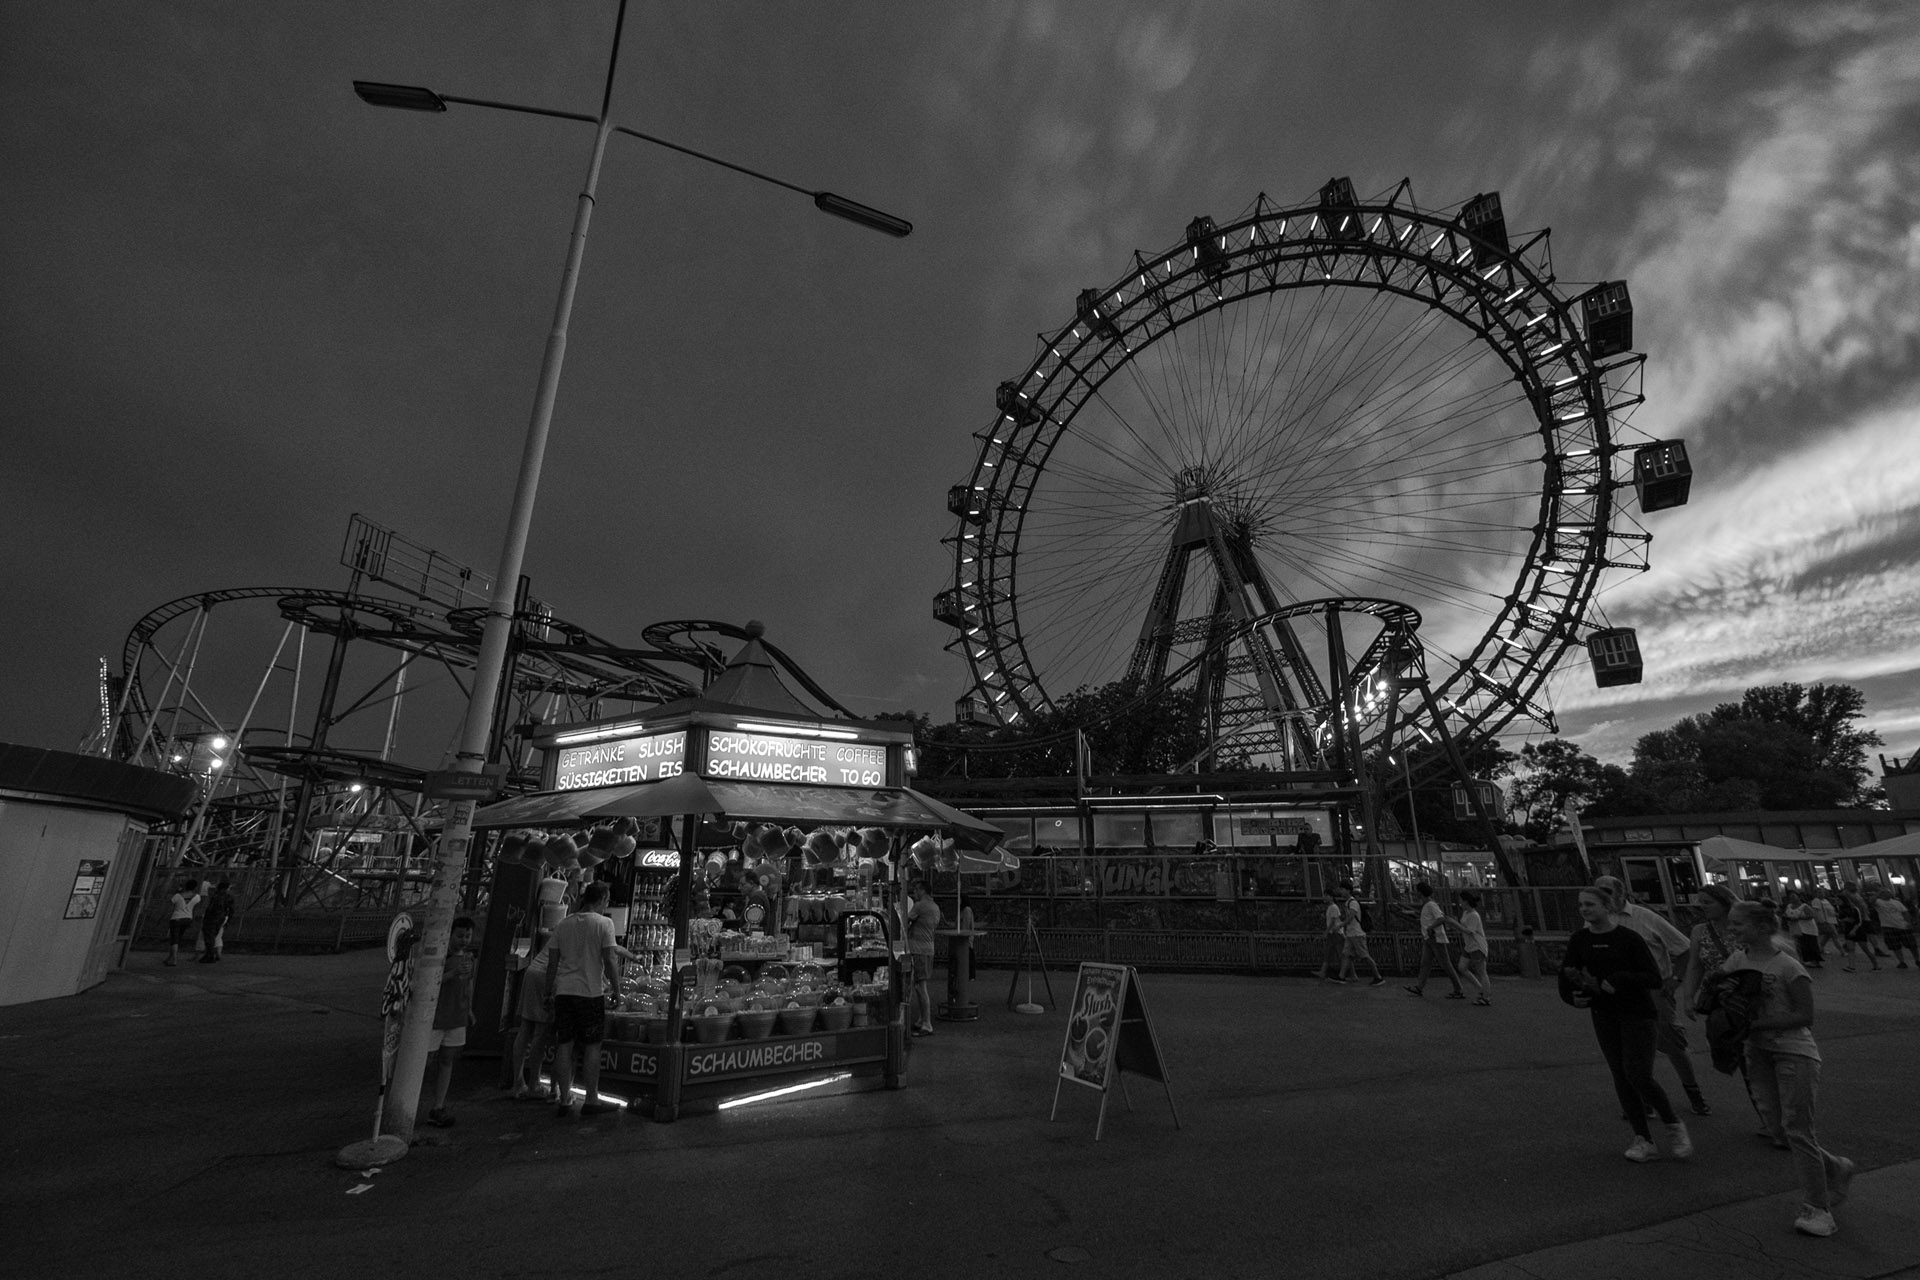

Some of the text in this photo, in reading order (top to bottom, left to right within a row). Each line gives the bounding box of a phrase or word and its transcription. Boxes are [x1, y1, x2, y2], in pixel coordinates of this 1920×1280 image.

[562, 737, 684, 768] GETRÄNKE SLUSH
[709, 736, 885, 765] SCHOKOFRÜCHTE COFFEE
[441, 775, 495, 787] LETTEN
[558, 760, 683, 790] SÜSSIGKEITEN EIS
[708, 759, 881, 786] SCHAUMBECHER TO GO
[642, 850, 681, 867] Coca-Co
[1081, 992, 1112, 1017] Slush
[630, 1052, 657, 1075] EIS
[690, 1041, 823, 1075] SCHAUMBECHER
